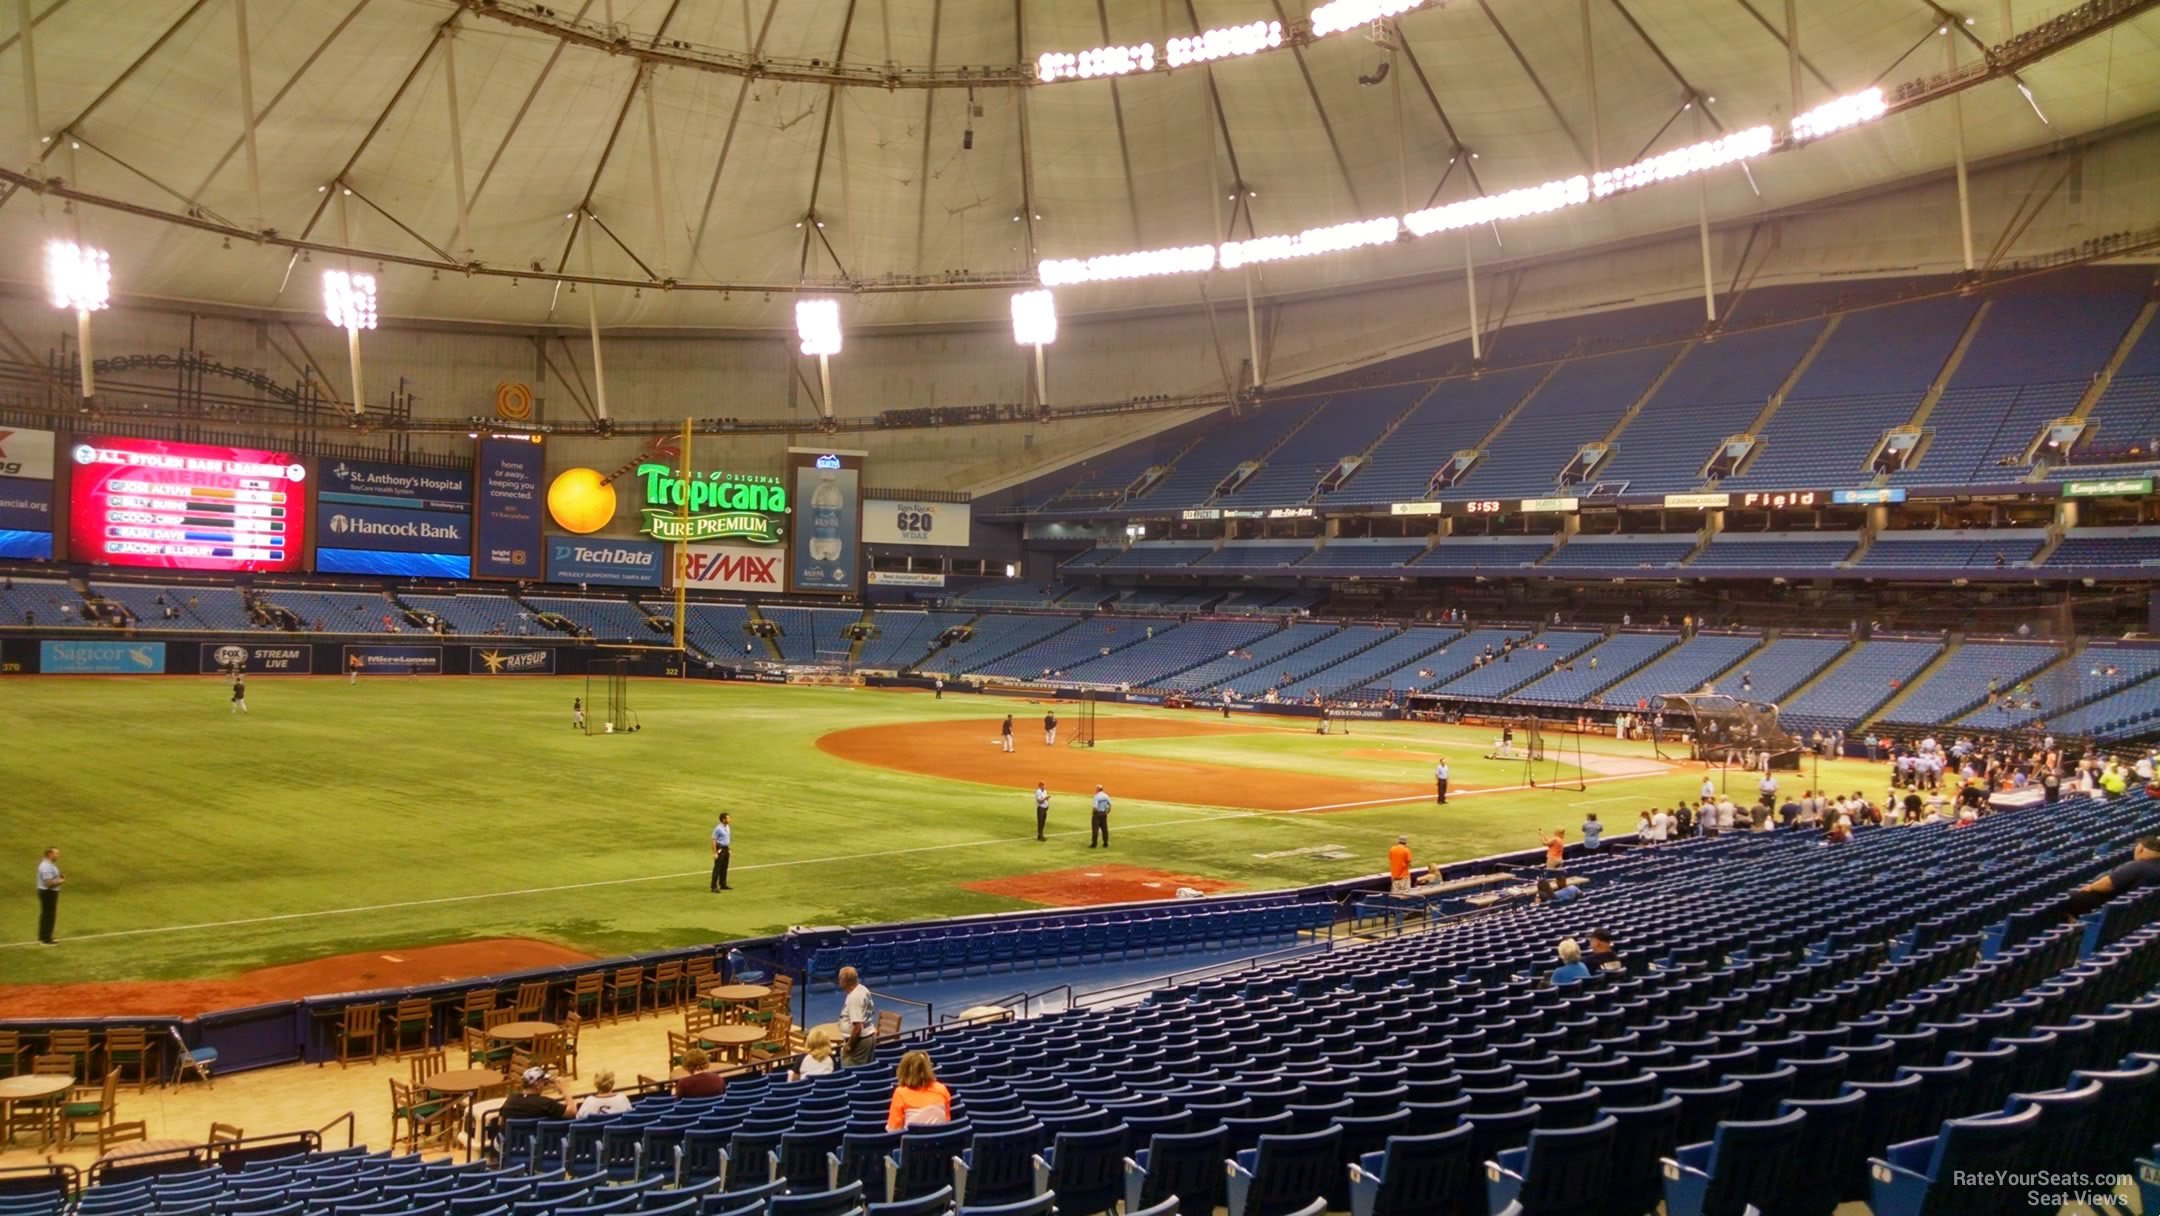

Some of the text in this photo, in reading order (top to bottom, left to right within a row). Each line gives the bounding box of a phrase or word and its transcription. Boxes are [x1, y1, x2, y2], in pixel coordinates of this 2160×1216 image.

[501, 460, 523, 469] home
[351, 472, 462, 491] St. Anthony's Hospital
[489, 477, 519, 490] keeping
[726, 474, 780, 484] ORIGINAL
[351, 484, 374, 492] BayCare
[637, 463, 786, 512] Tropicana
[490, 491, 532, 499] connected.
[1745, 492, 1814, 506] Field
[1467, 501, 1499, 512] 5:53
[350, 518, 418, 537] Hancock
[697, 517, 767, 535] PREMIUM
[897, 512, 932, 532] 620
[675, 552, 777, 583] RE/MAX
[53, 643, 124, 666] Sagicor
[222, 649, 240, 657] FOX
[254, 649, 299, 659] STREAM
[507, 650, 547, 667] RAYSUP
[265, 659, 288, 668] LIVE
